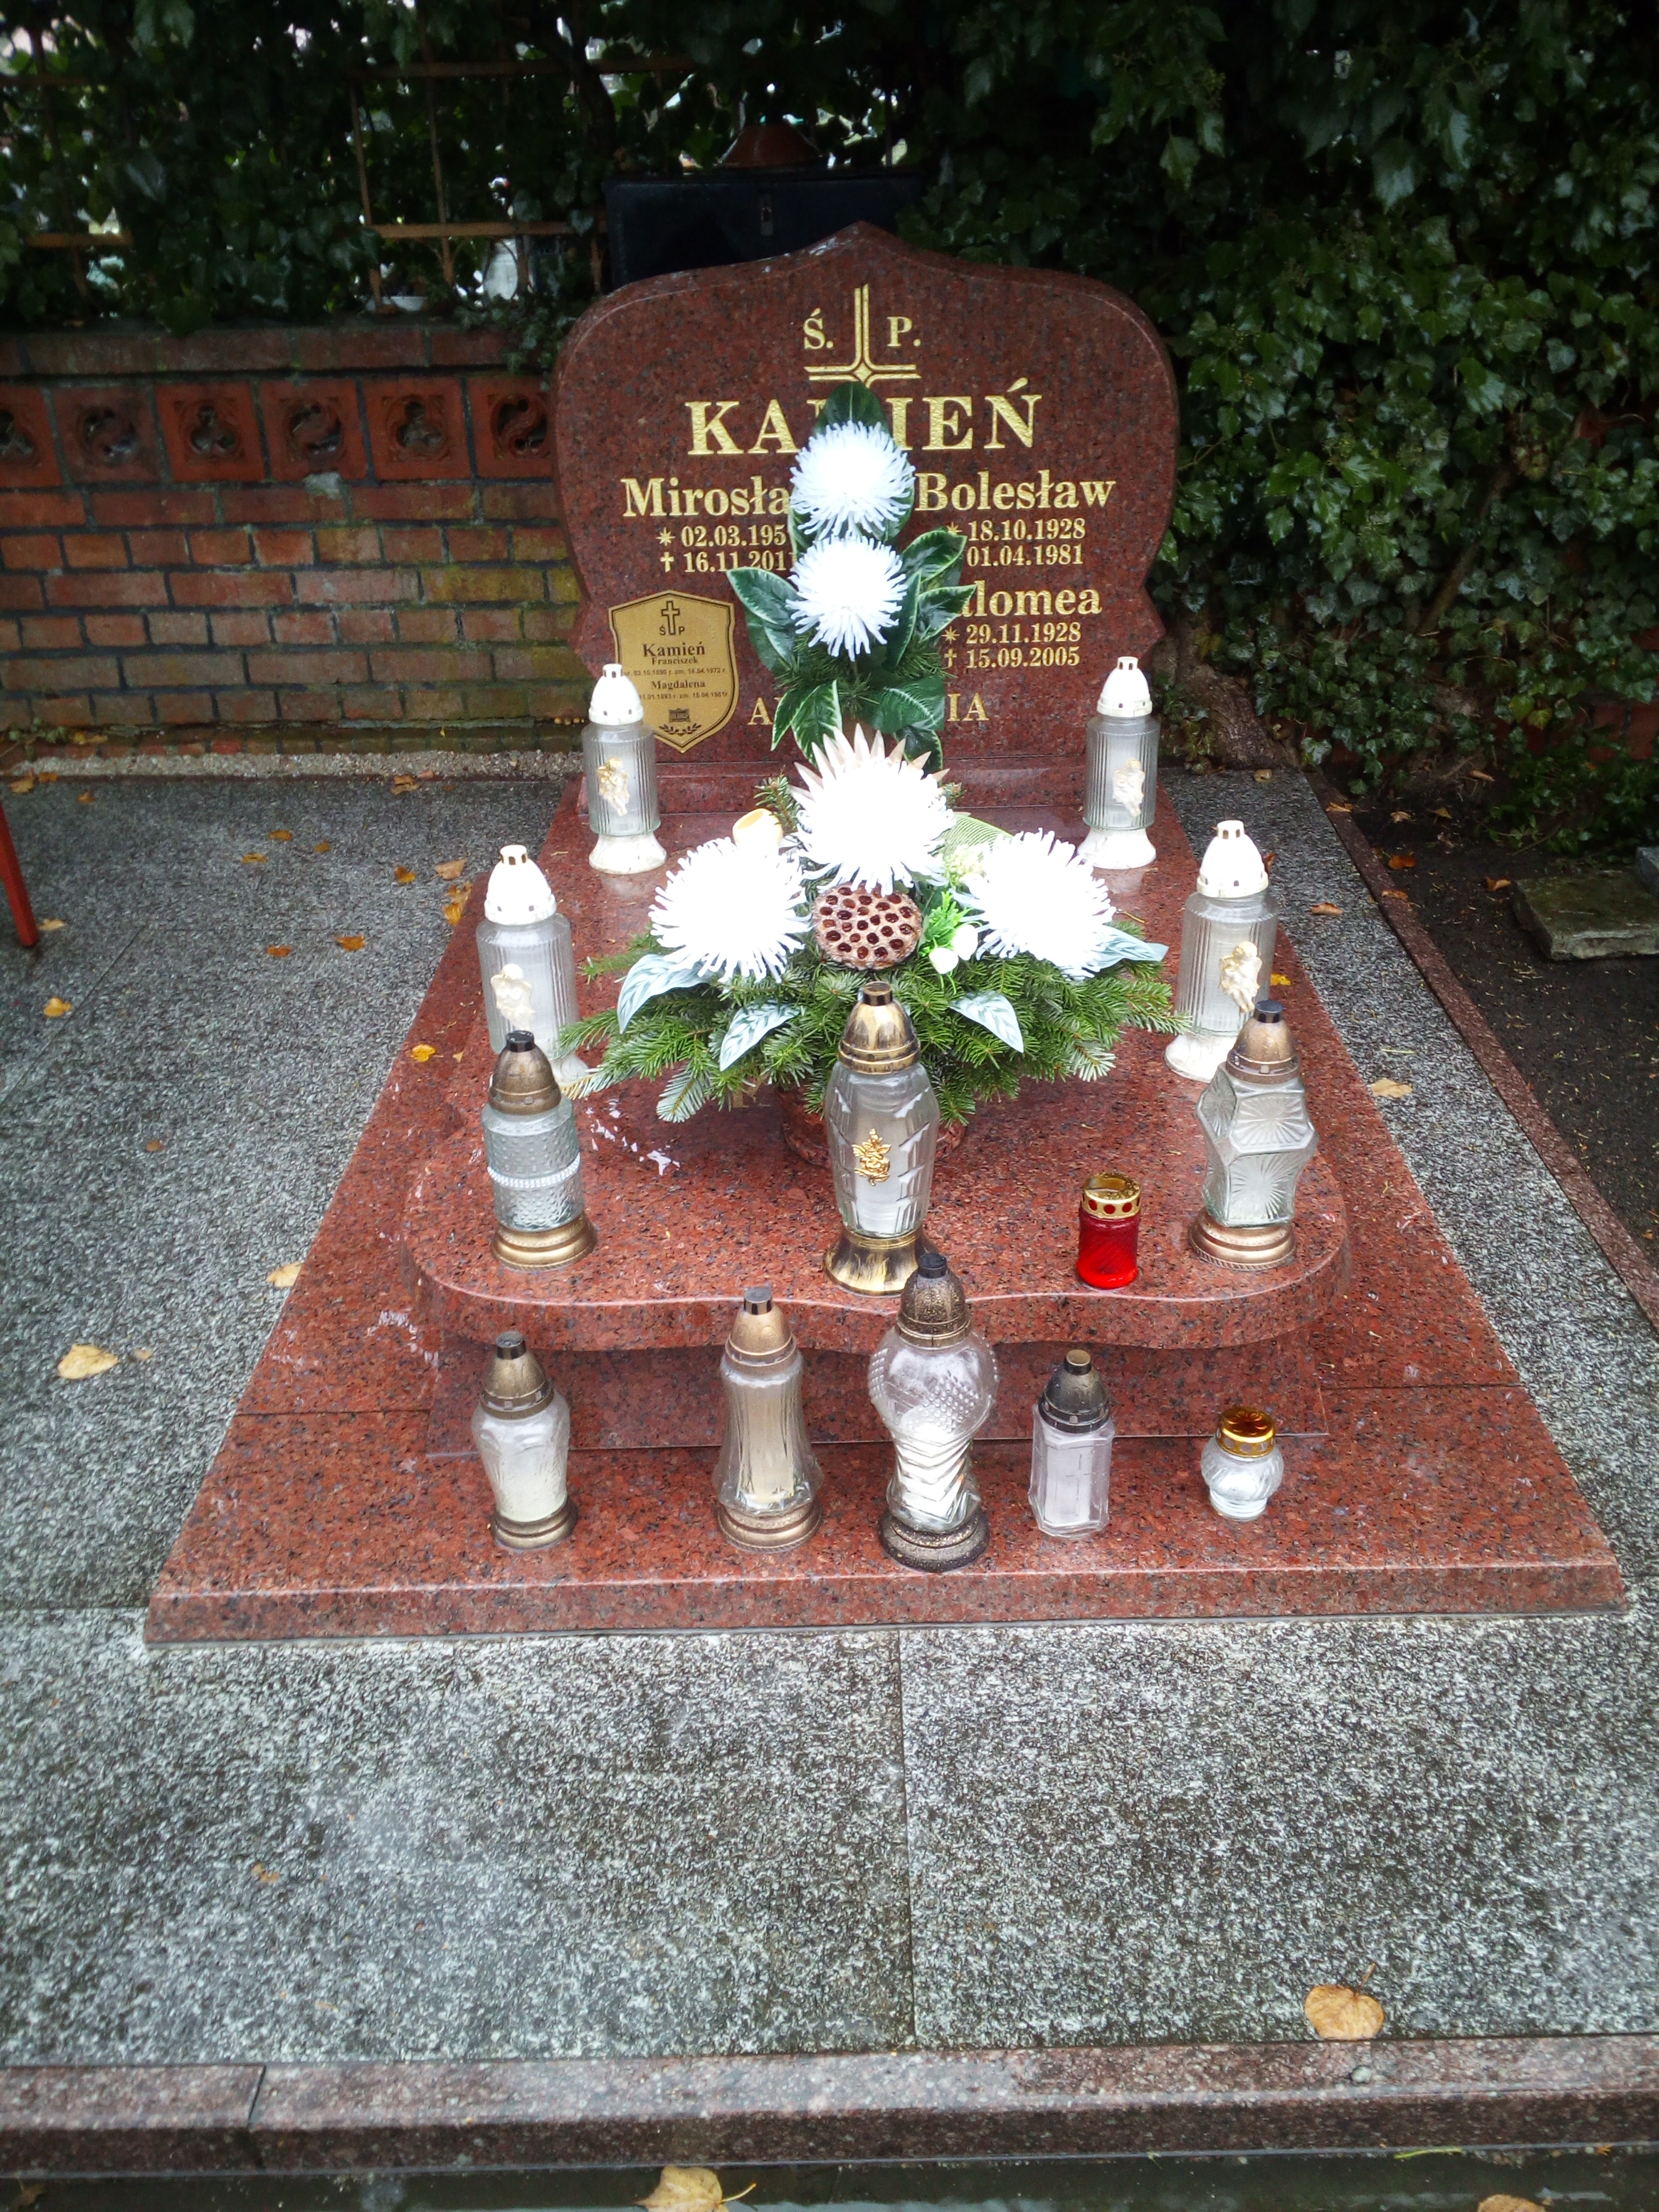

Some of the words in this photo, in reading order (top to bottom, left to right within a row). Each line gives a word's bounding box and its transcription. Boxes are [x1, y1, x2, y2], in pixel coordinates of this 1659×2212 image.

[803, 307, 834, 349] Ś.
[886, 316, 921, 348] P.
[684, 377, 1043, 455] KAIEŃ
[620, 475, 790, 517] Mirosła
[915, 469, 1117, 512] Bolesław
[681, 523, 787, 547] 02.03.195
[968, 518, 1086, 541] 18.10.1928
[966, 542, 1084, 567] 01.04.1981
[678, 626, 685, 635] P
[966, 622, 1082, 644] 29.11.1928
[643, 641, 706, 657] Kamień
[652, 656, 699, 665] Franciszek
[966, 646, 1080, 669] 15.09.2005
[651, 680, 706, 691] Magdalena
